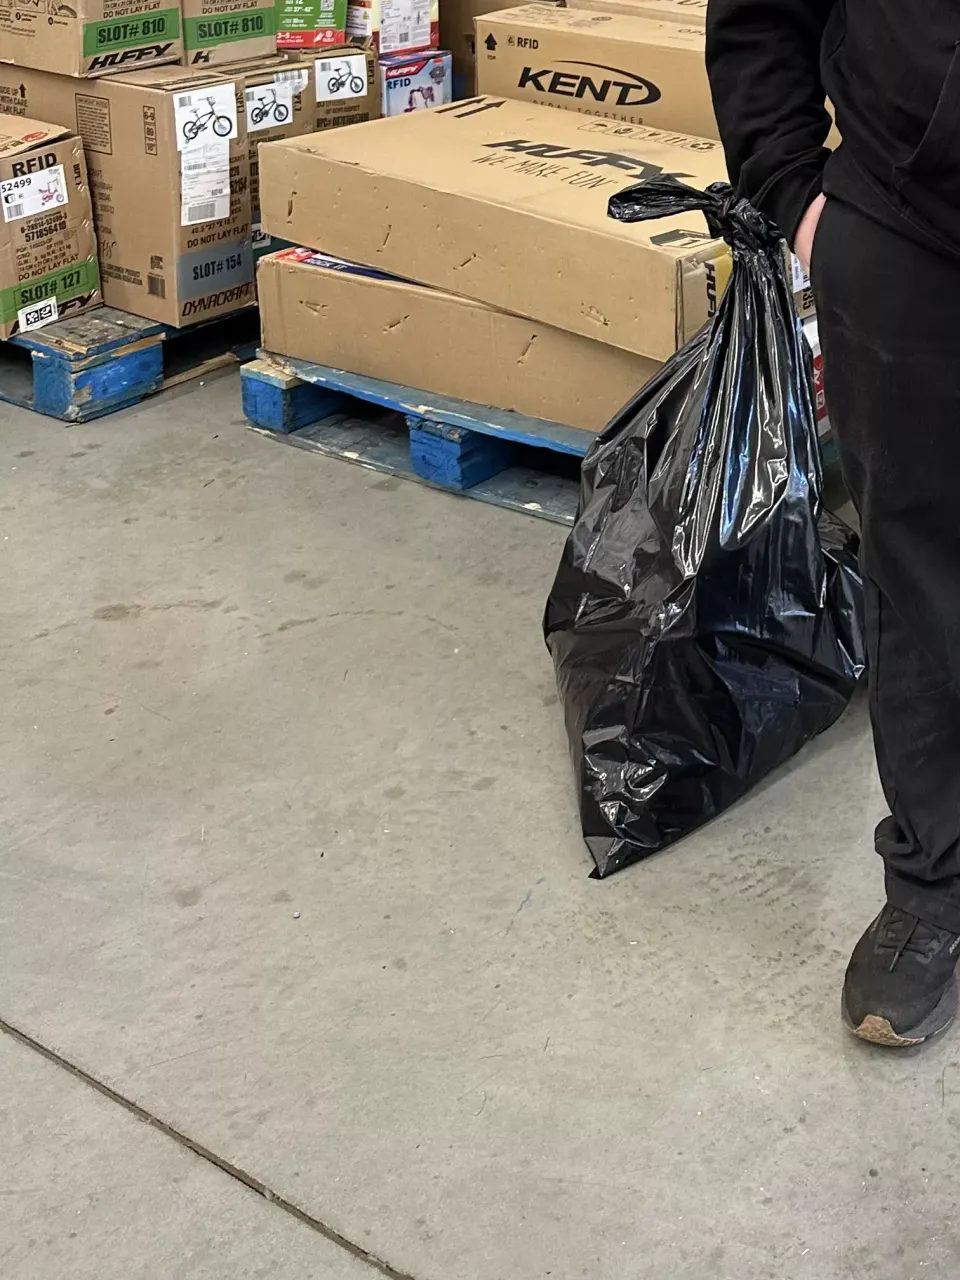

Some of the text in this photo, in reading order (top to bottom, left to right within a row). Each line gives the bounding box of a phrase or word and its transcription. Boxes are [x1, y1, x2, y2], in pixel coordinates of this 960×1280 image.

[103, 2, 160, 19] DO NOT LAY FLAT
[202, 1, 258, 15] DO NOT LAY FLAT
[98, 17, 166, 45] SLOT# 810
[198, 15, 264, 39] SLOT# 810
[516, 36, 539, 50] RFID
[87, 42, 174, 71] HUFFY
[0, 85, 12, 94] IDE
[386, 76, 411, 90] RFID
[518, 66, 650, 106] KENT
[2, 105, 26, 116] LAY FLAT
[13, 98, 28, 108] CARE
[11, 152, 57, 178] RFID
[472, 152, 509, 167] WE
[511, 159, 560, 178] MAKE
[480, 139, 698, 181] HUFFY
[1, 177, 32, 193] 52499
[187, 223, 249, 249] DO NOT LAY FLAT
[18, 253, 80, 282] DO NOT LAY FLAT
[193, 253, 243, 281] SLOT# 154
[20, 270, 81, 305] SLOT# 127
[182, 281, 253, 317] DYNACRAFT
[703, 260, 717, 318] HUF
